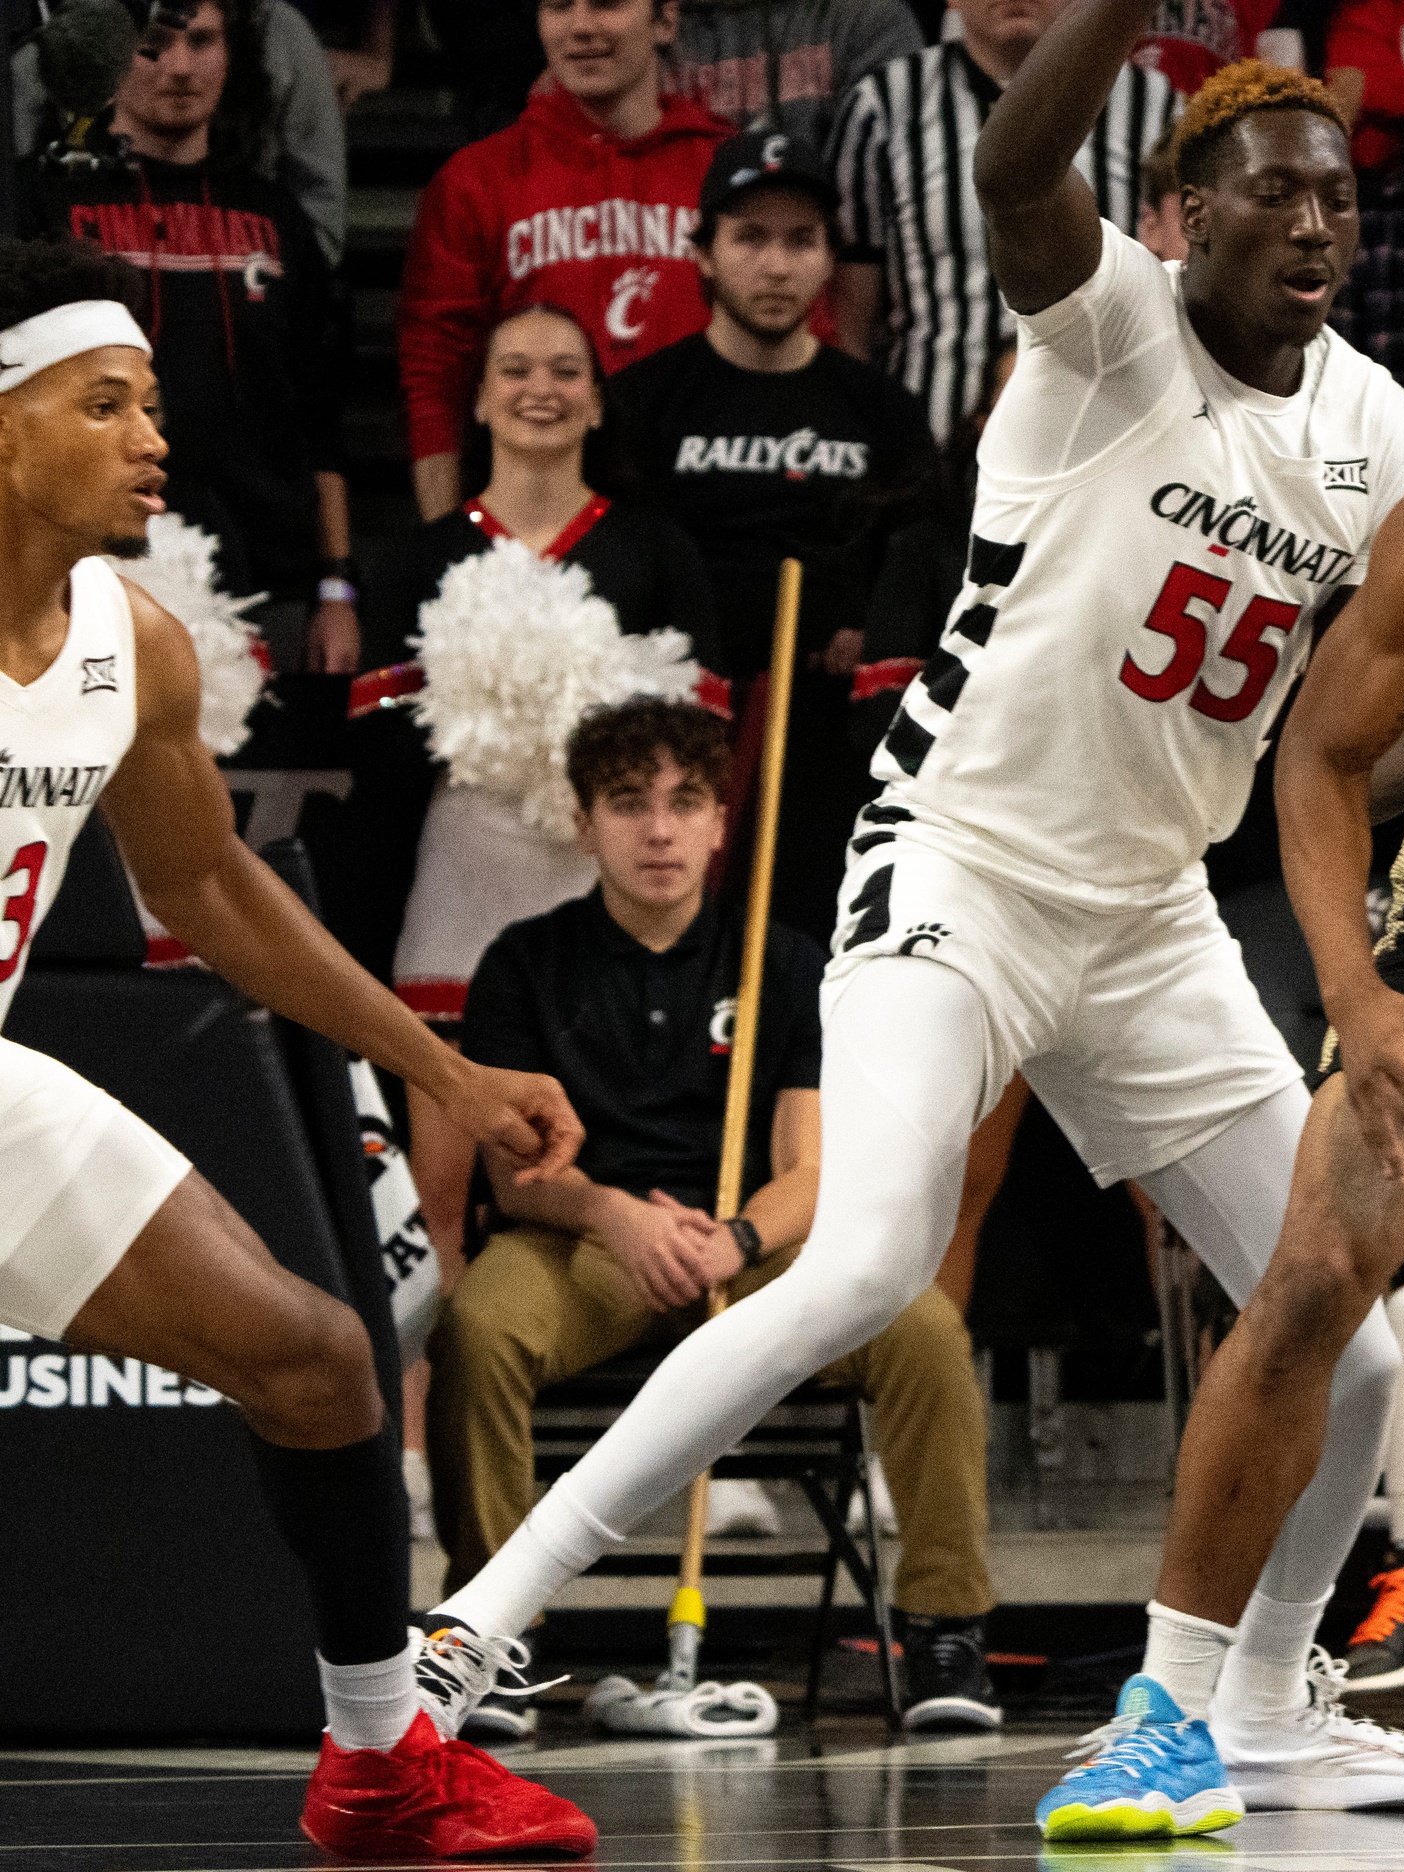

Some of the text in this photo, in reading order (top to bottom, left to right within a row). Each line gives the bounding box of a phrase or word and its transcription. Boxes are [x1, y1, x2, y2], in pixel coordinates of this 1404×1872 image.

[1149, 481, 1357, 585] CINCINNATI
[1119, 560, 1303, 723] 55
[0, 764, 108, 808] INNATI
